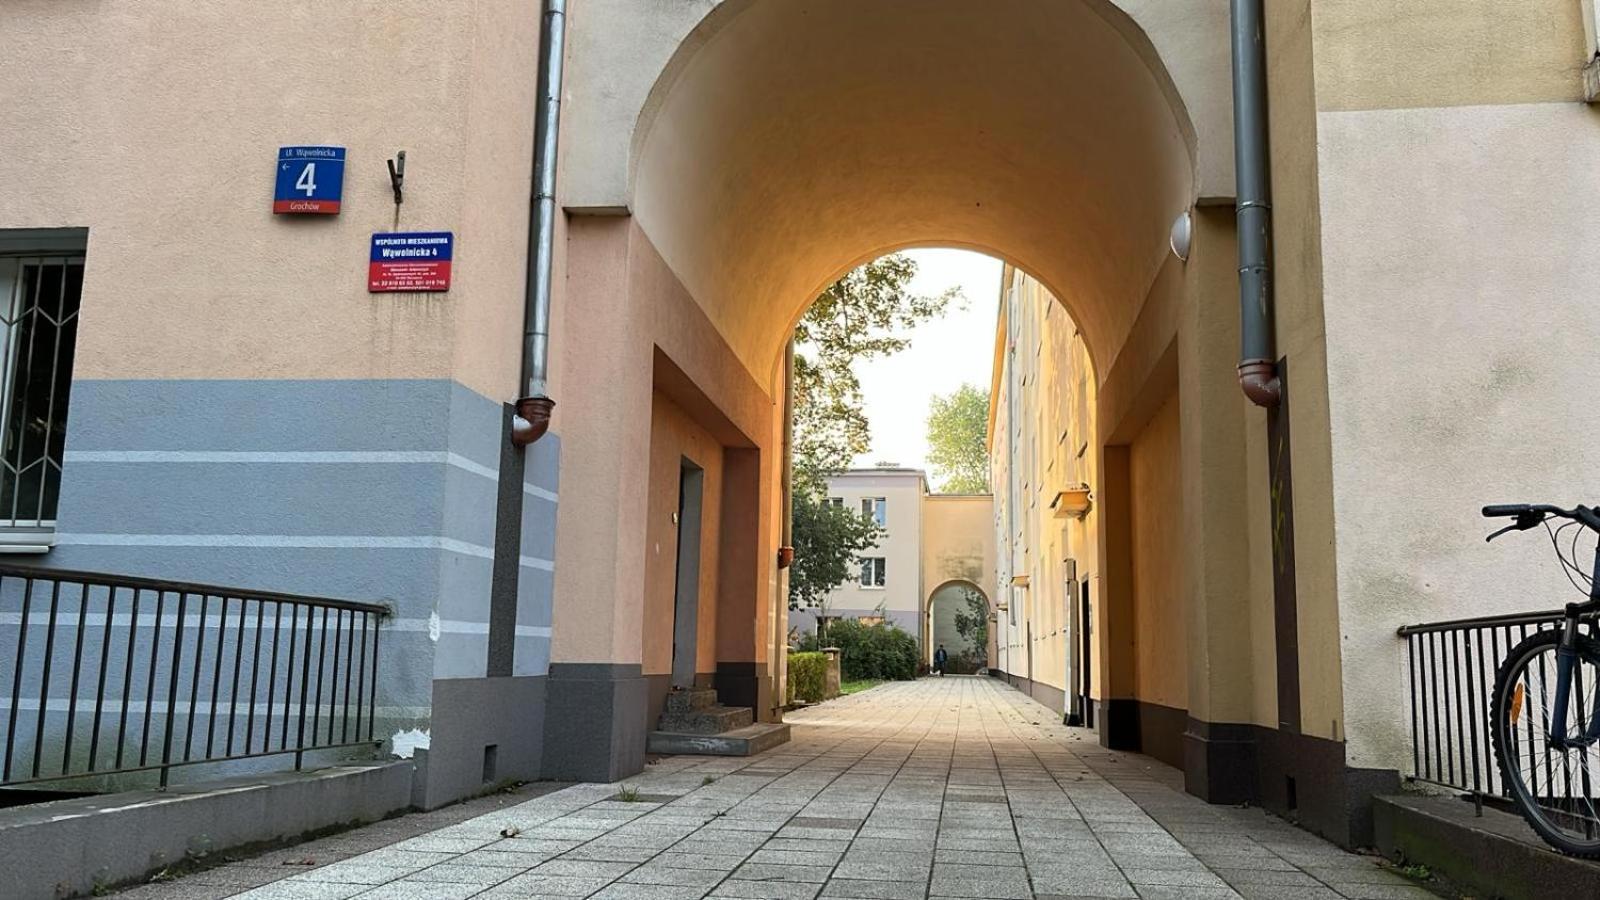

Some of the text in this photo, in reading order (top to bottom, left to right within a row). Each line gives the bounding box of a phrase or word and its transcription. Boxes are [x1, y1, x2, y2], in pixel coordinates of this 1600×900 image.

[295, 163, 316, 197] 4
[290, 201, 320, 211] Grochów
[382, 248, 437, 258] Wąwolnicka 4
